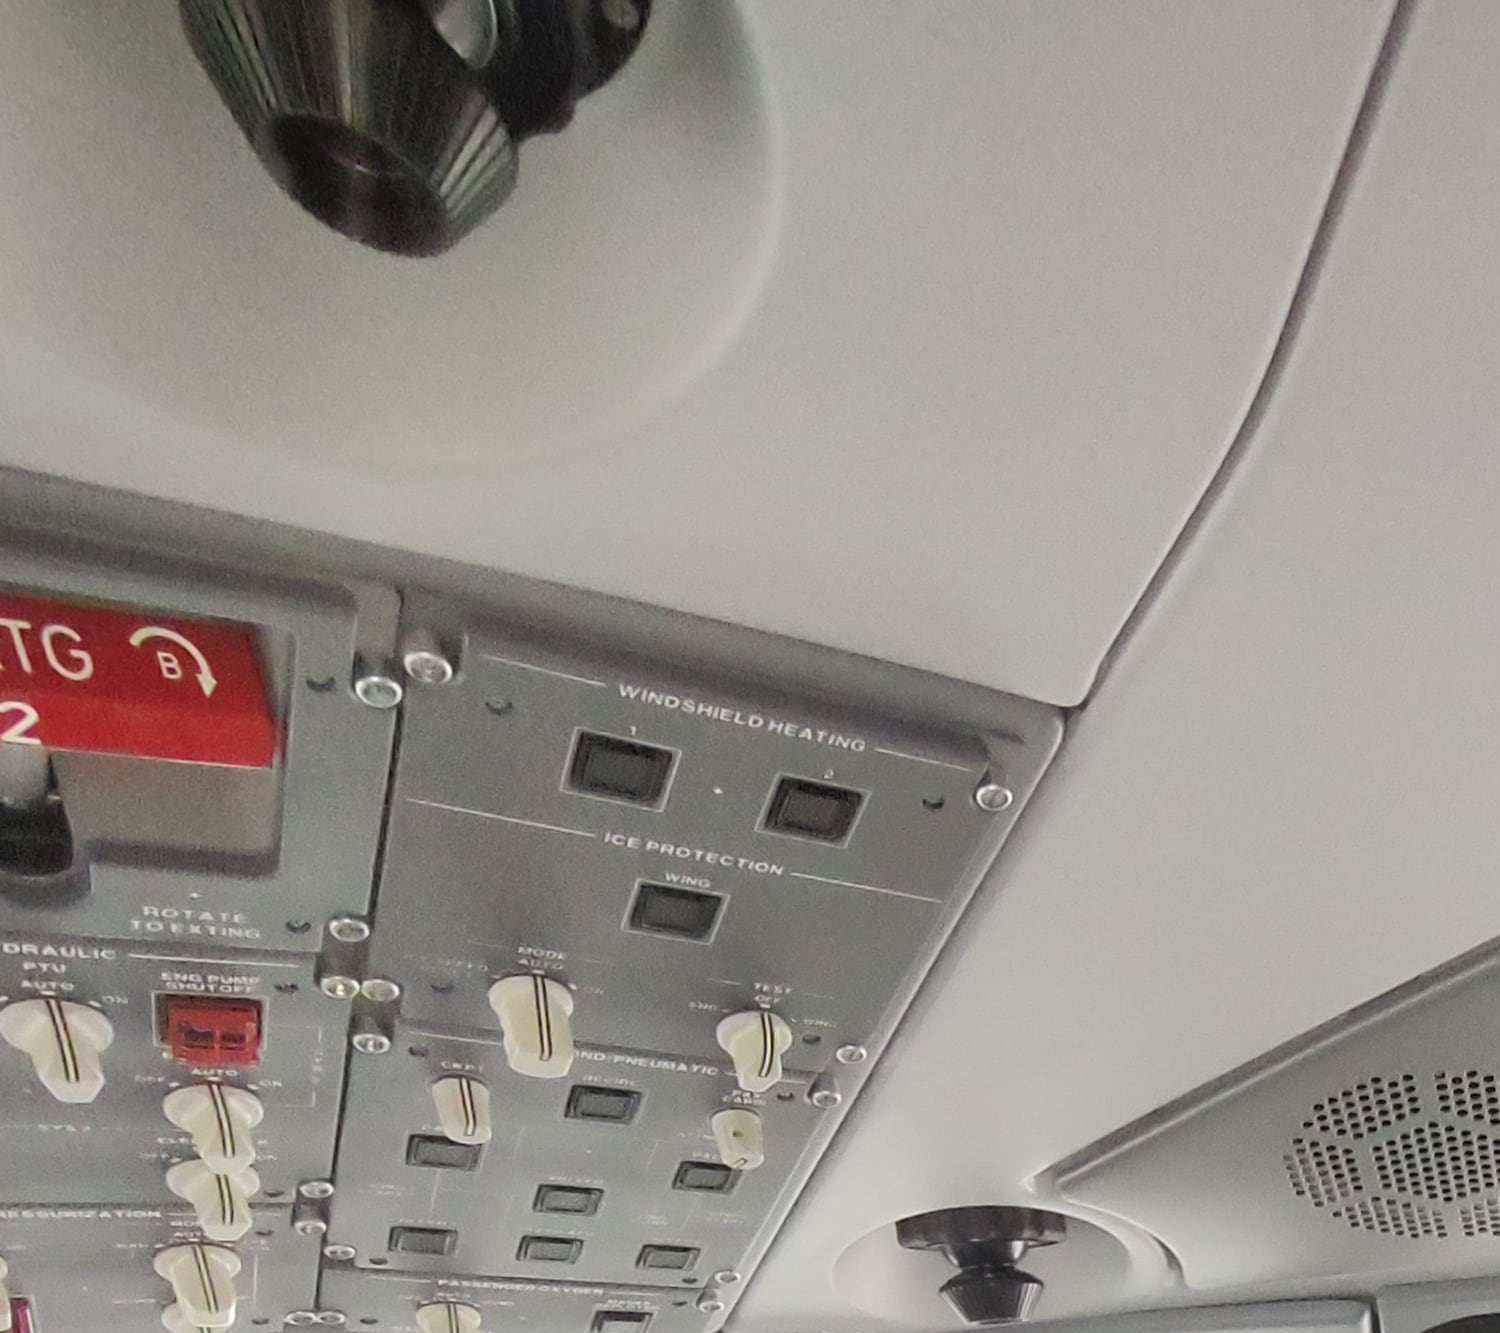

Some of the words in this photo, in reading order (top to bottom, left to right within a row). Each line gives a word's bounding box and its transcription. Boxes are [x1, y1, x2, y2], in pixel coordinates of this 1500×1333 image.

[157, 651, 182, 680] B
[619, 683, 764, 728] WINDSHIELD
[766, 719, 867, 753] HEATING
[602, 830, 641, 850] ICE
[646, 840, 785, 876] PROTECTION
[665, 872, 711, 887] WING
[143, 905, 247, 924] ROTATE
[131, 919, 165, 933] TO
[170, 921, 261, 940] EXTING
[23, 961, 67, 973] PTU
[20, 979, 75, 991] AUTO
[207, 974, 261, 985] PUMP
[166, 982, 254, 994] SHUTOFF
[753, 982, 794, 995] TEST
[191, 1067, 239, 1078] AUTO
[437, 1278, 537, 1293] PASSENGER
[536, 1285, 604, 1296] OXYGEN
